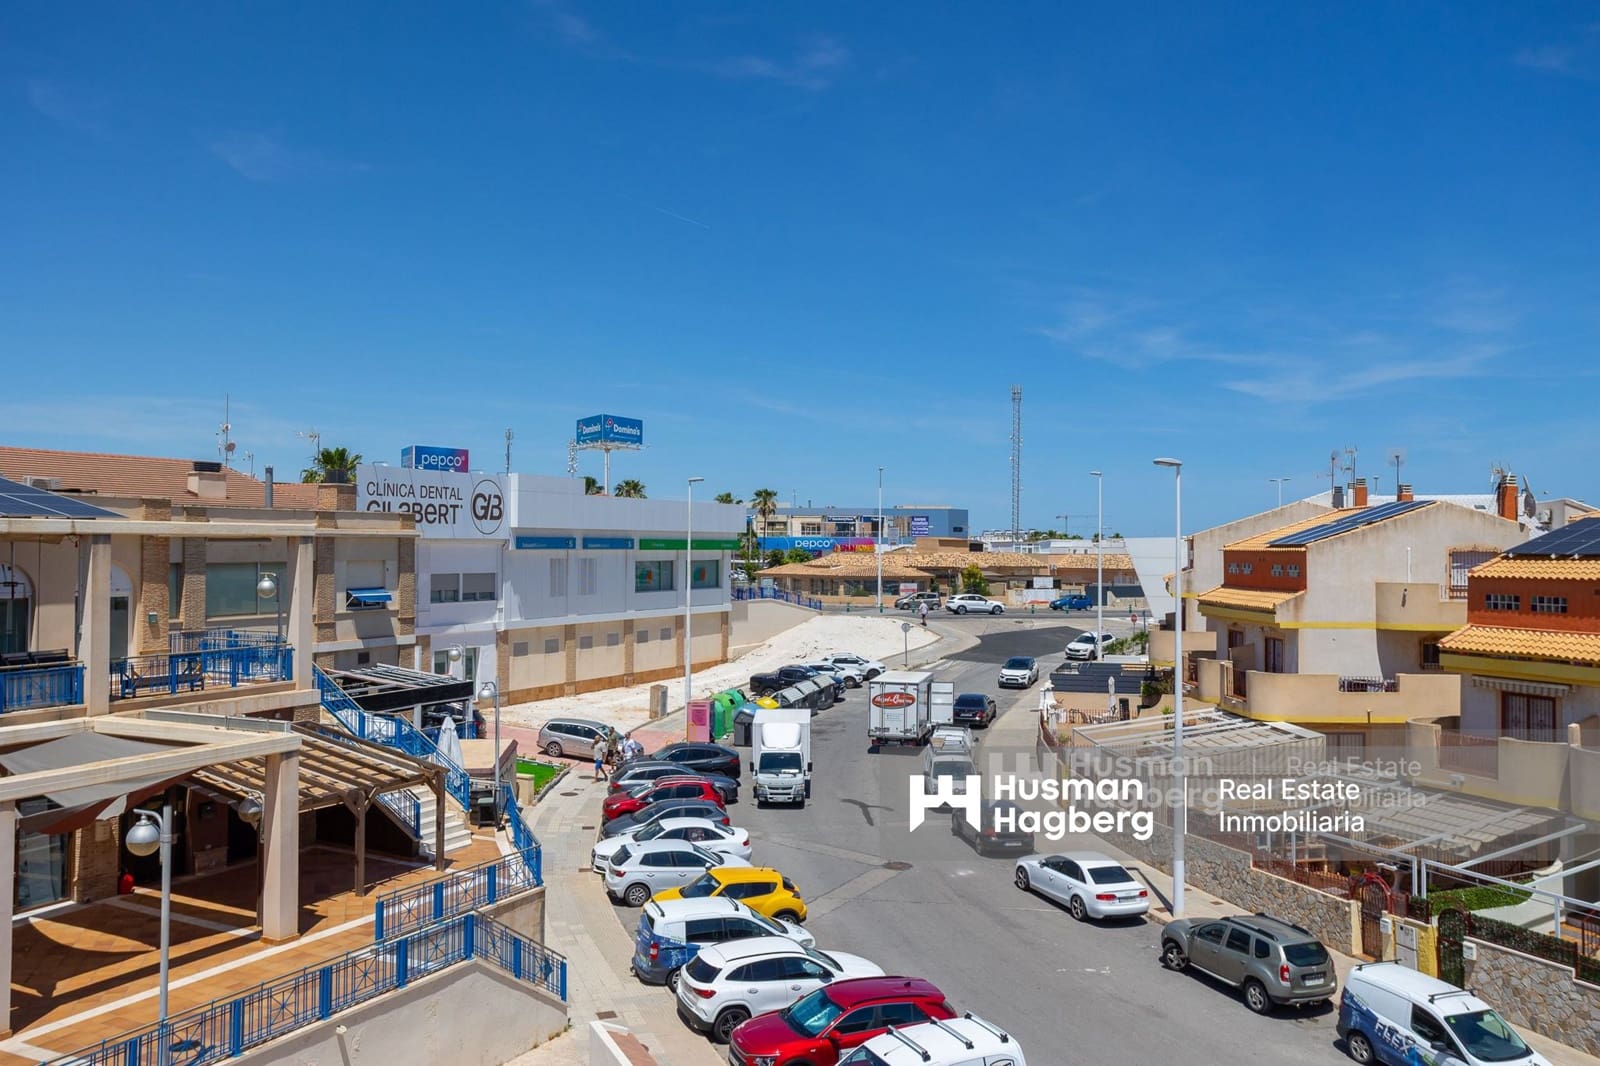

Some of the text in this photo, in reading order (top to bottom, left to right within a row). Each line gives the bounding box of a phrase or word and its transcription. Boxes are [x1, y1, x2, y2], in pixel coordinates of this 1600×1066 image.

[613, 424, 640, 436] Domino's
[421, 454, 462, 467] pepco
[366, 479, 463, 501] CLÍNICA DENTAL
[795, 539, 831, 549] pepco
